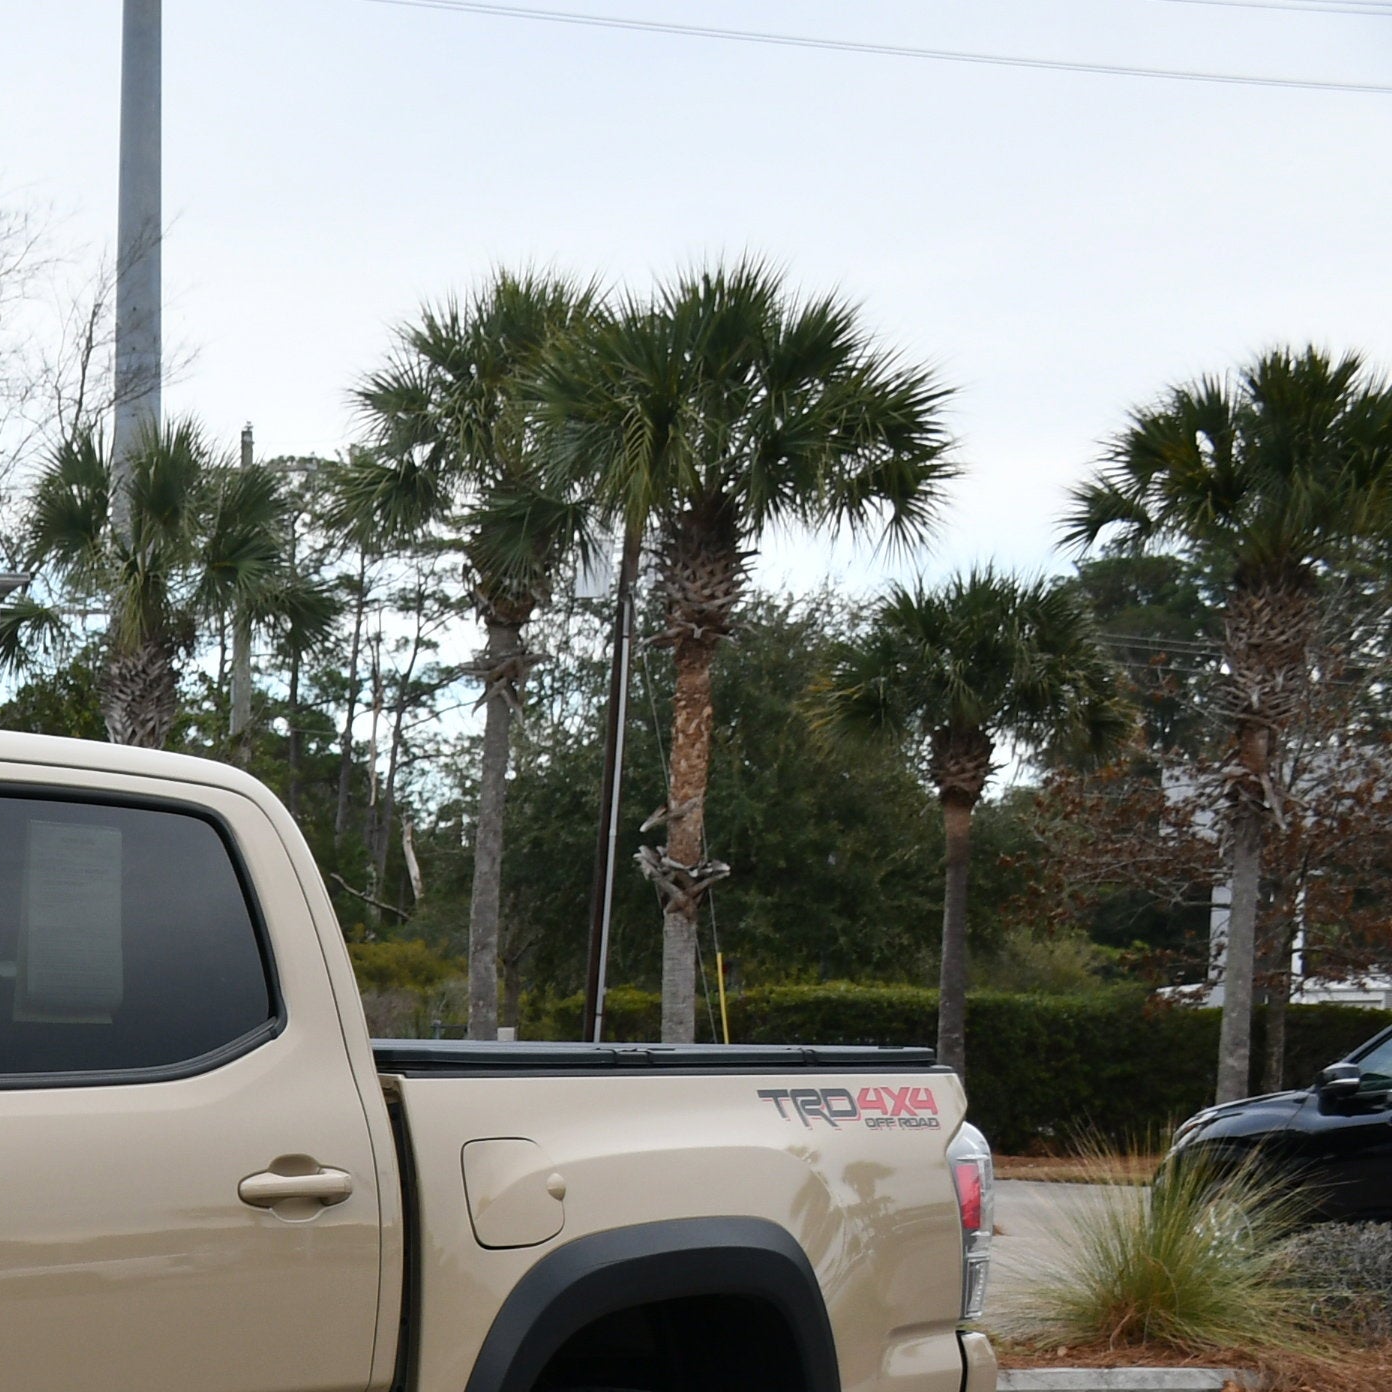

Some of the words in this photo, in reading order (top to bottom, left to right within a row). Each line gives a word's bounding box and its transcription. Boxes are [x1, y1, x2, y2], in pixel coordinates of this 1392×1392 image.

[757, 1088, 859, 1129] TRD
[865, 1117, 895, 1129] OFF
[898, 1117, 940, 1129] ROAD
